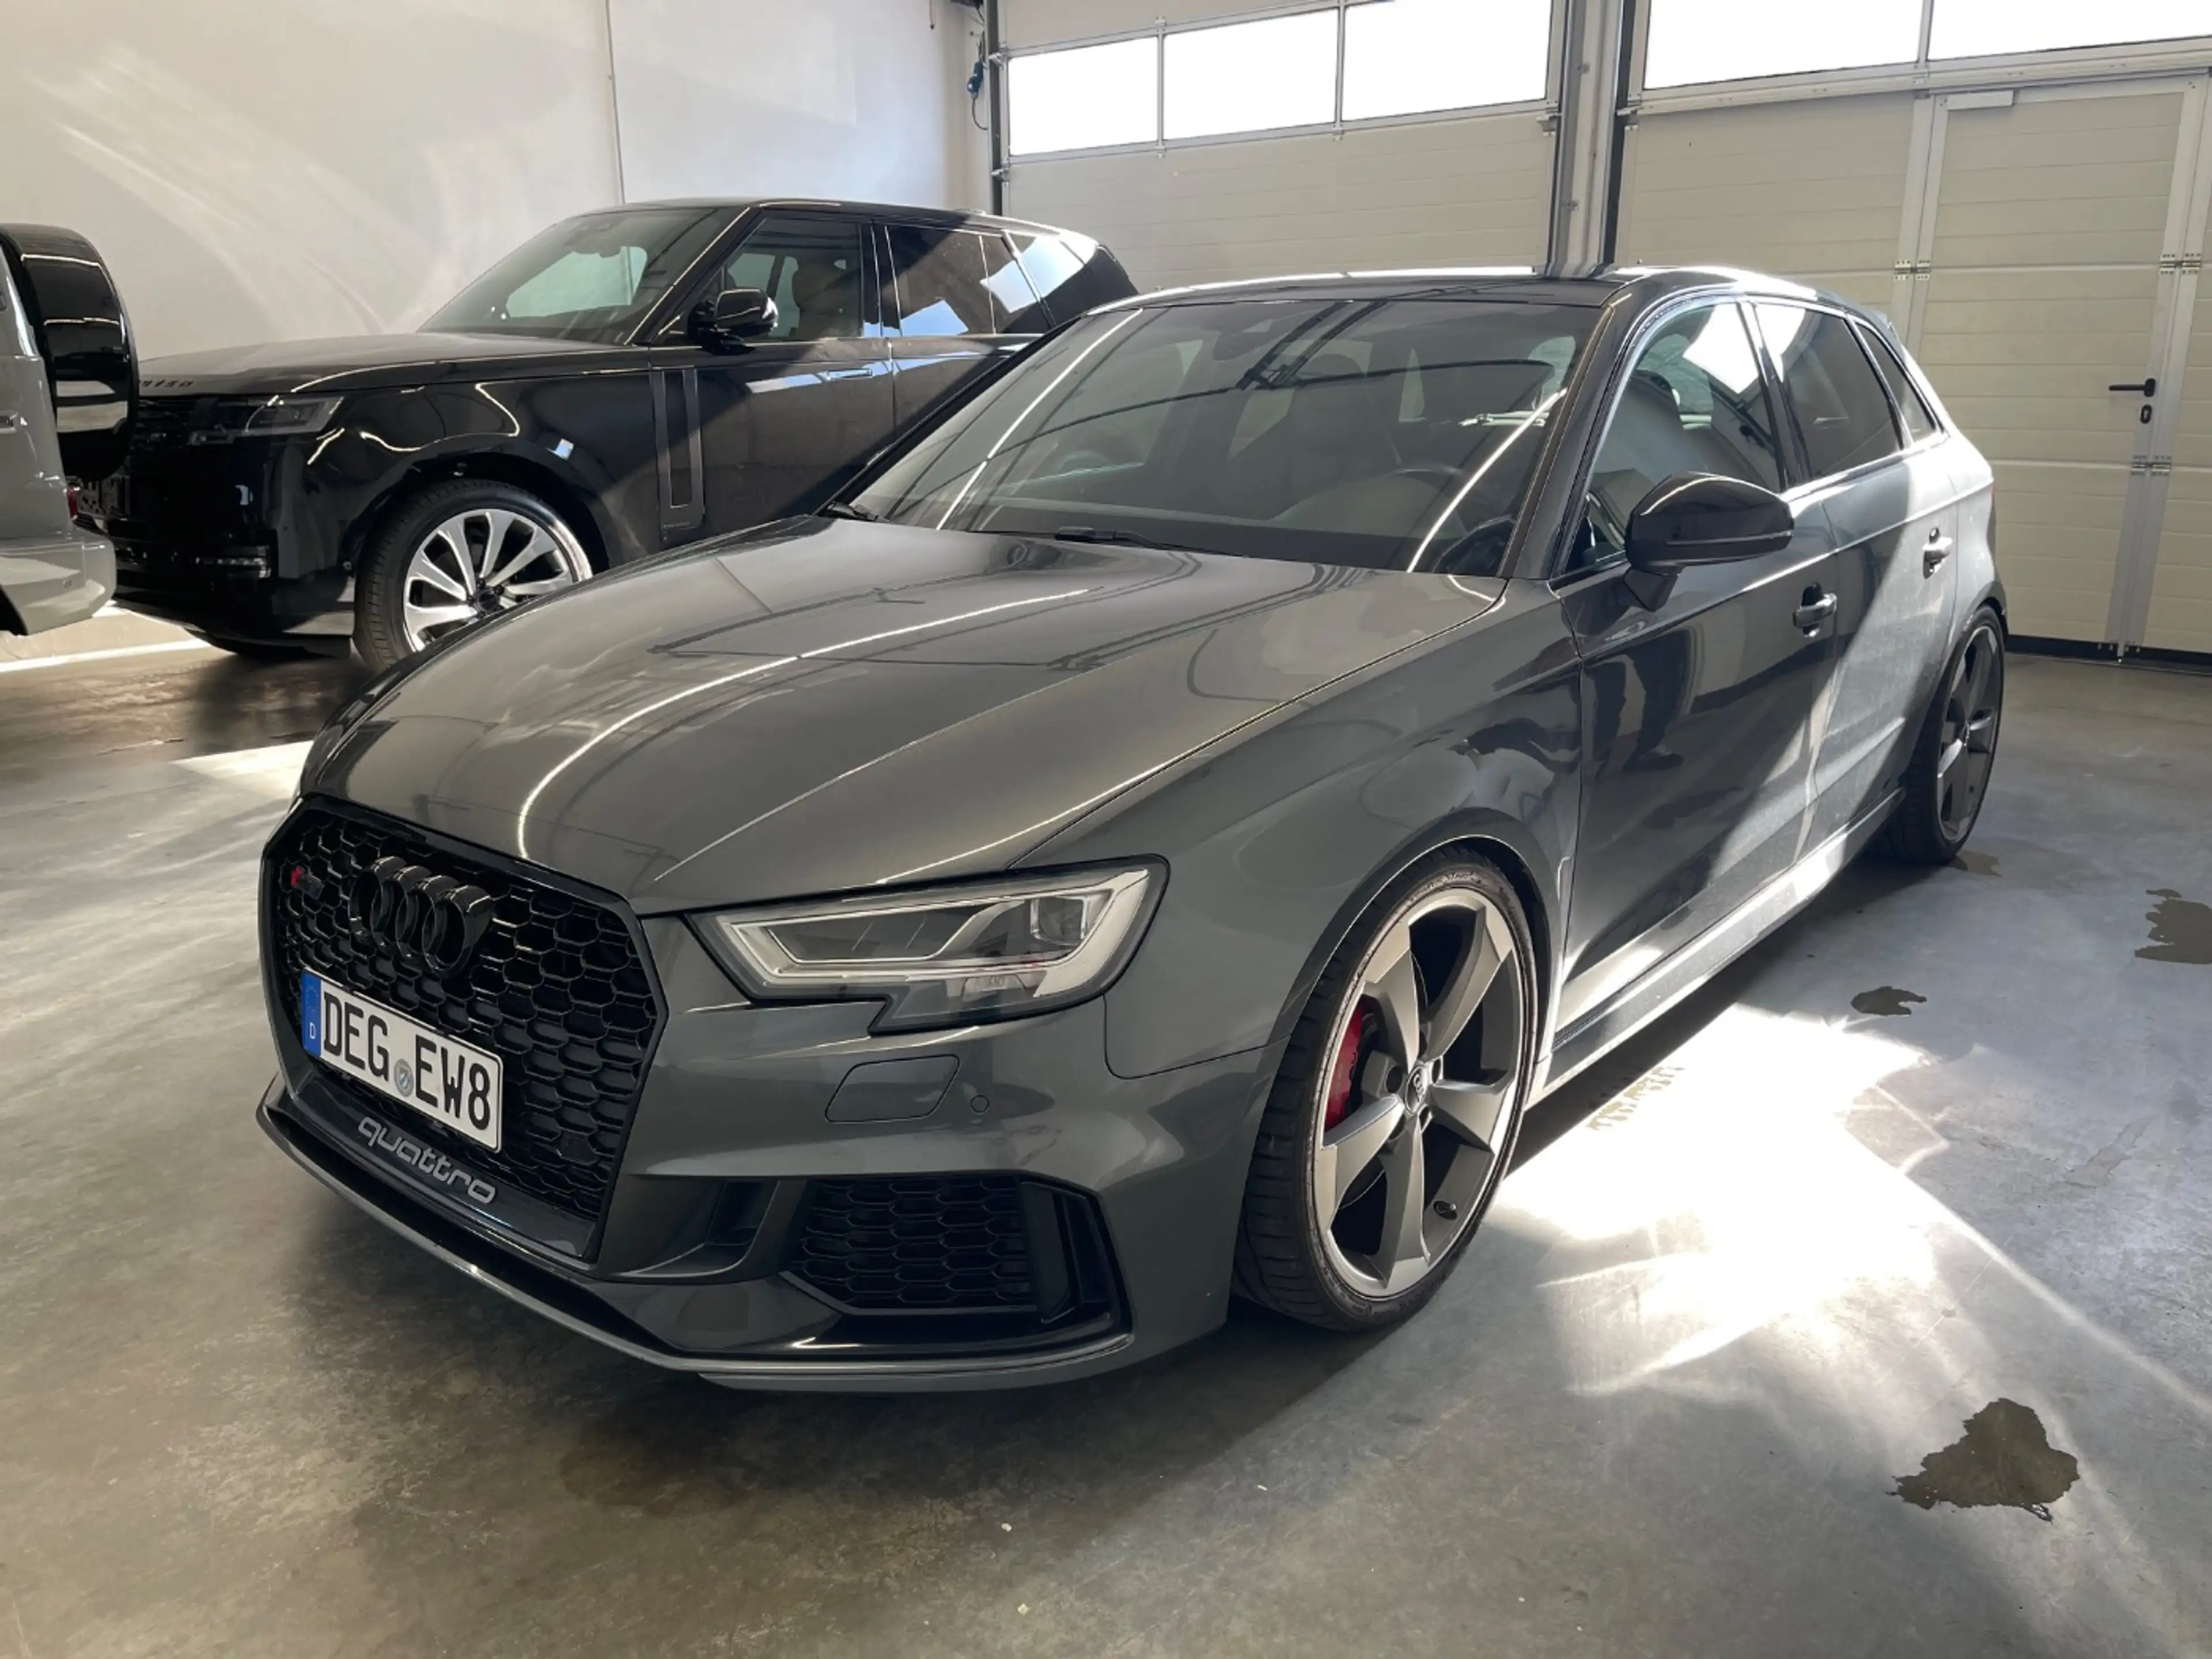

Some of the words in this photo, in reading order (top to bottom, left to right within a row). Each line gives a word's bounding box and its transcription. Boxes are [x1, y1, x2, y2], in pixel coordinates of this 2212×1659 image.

[309, 1022, 316, 1039] D
[324, 991, 390, 1082] DEG
[415, 1034, 490, 1131] EW8
[358, 1116, 495, 1204] quattro
